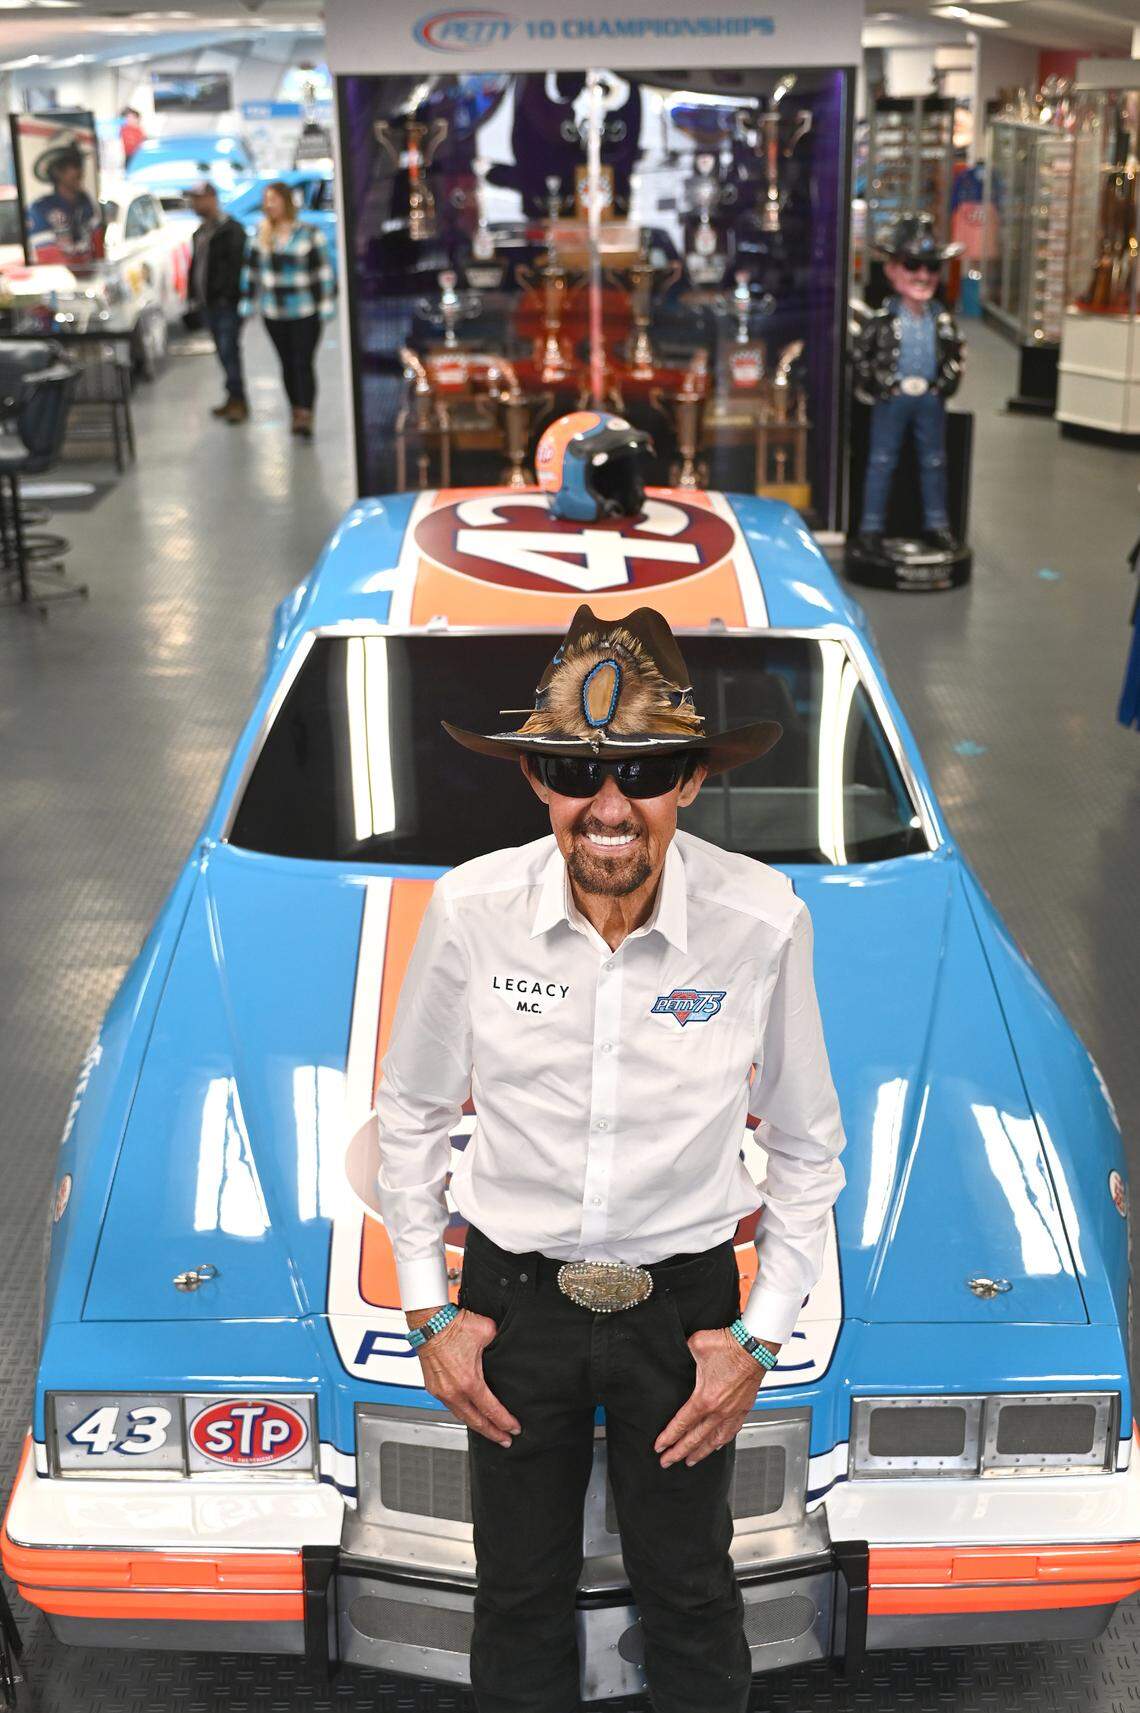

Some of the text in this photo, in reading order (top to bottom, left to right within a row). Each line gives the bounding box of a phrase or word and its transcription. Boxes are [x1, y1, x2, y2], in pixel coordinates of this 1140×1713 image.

[526, 20, 556, 39] 10
[562, 16, 776, 38] CHAMPIONSHIPS
[493, 976, 570, 999] LEGACY
[516, 1001, 542, 1014] M.C.
[68, 1406, 172, 1455] 43
[205, 1406, 290, 1456] STP
